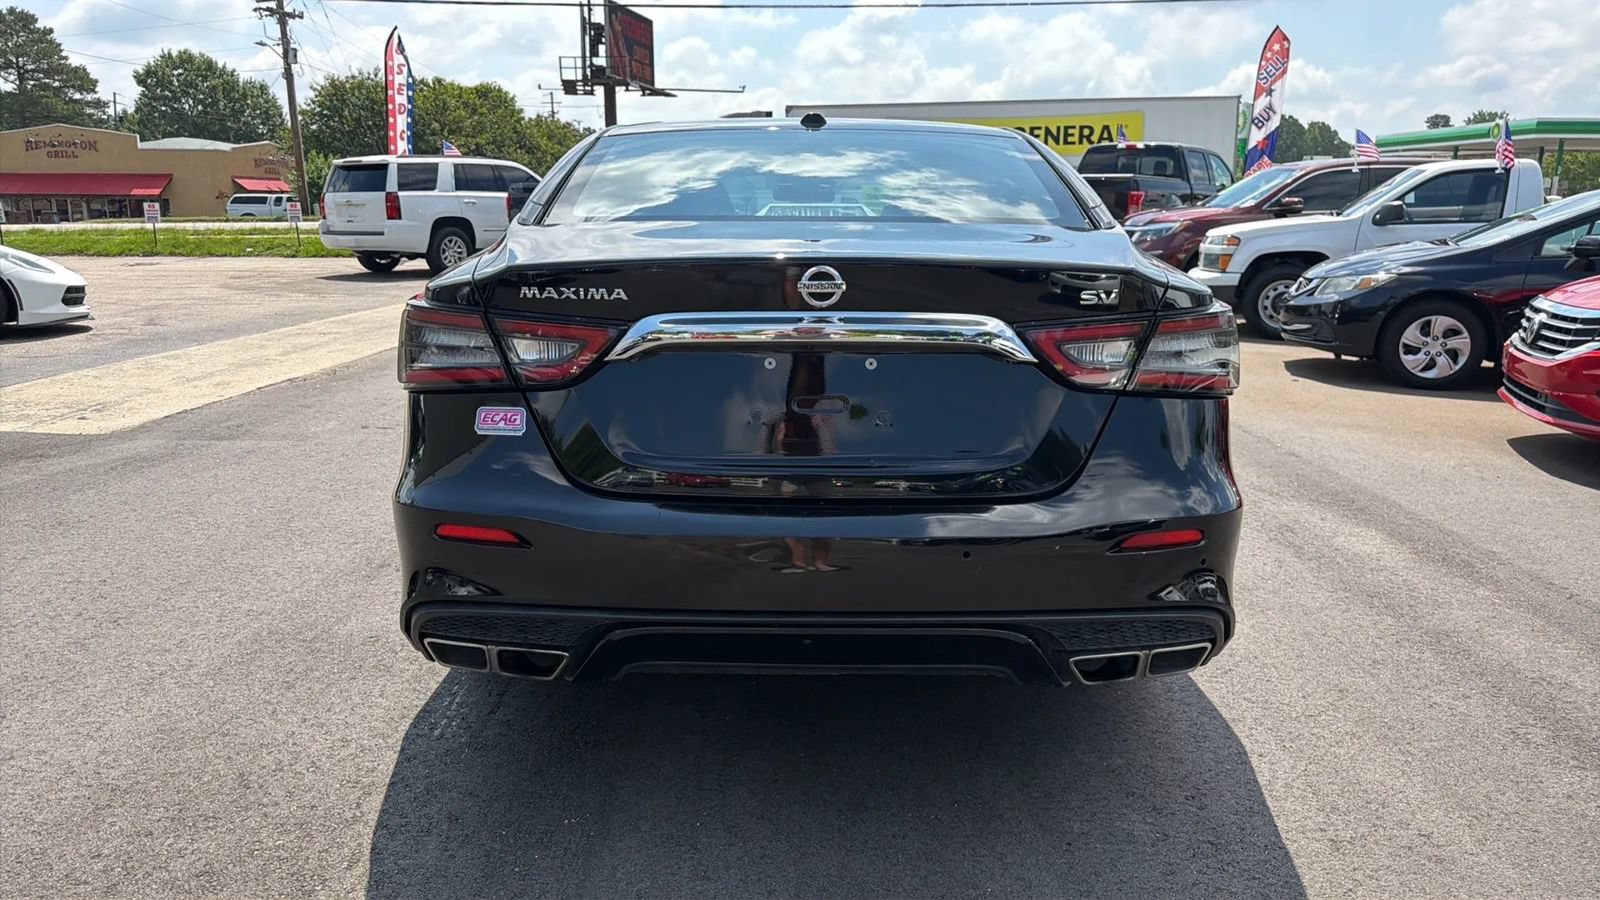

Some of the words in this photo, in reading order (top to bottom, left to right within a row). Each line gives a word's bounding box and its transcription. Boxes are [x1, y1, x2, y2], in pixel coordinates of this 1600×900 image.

[1258, 55, 1287, 86] SELL
[1252, 103, 1277, 130] BUY
[1014, 124, 1124, 146] ENERA
[25, 140, 98, 152] REMNGON
[46, 150, 78, 159] GRILL
[519, 286, 629, 301] MAXIMA
[1079, 289, 1119, 305] SV
[481, 412, 519, 425] ECAG
